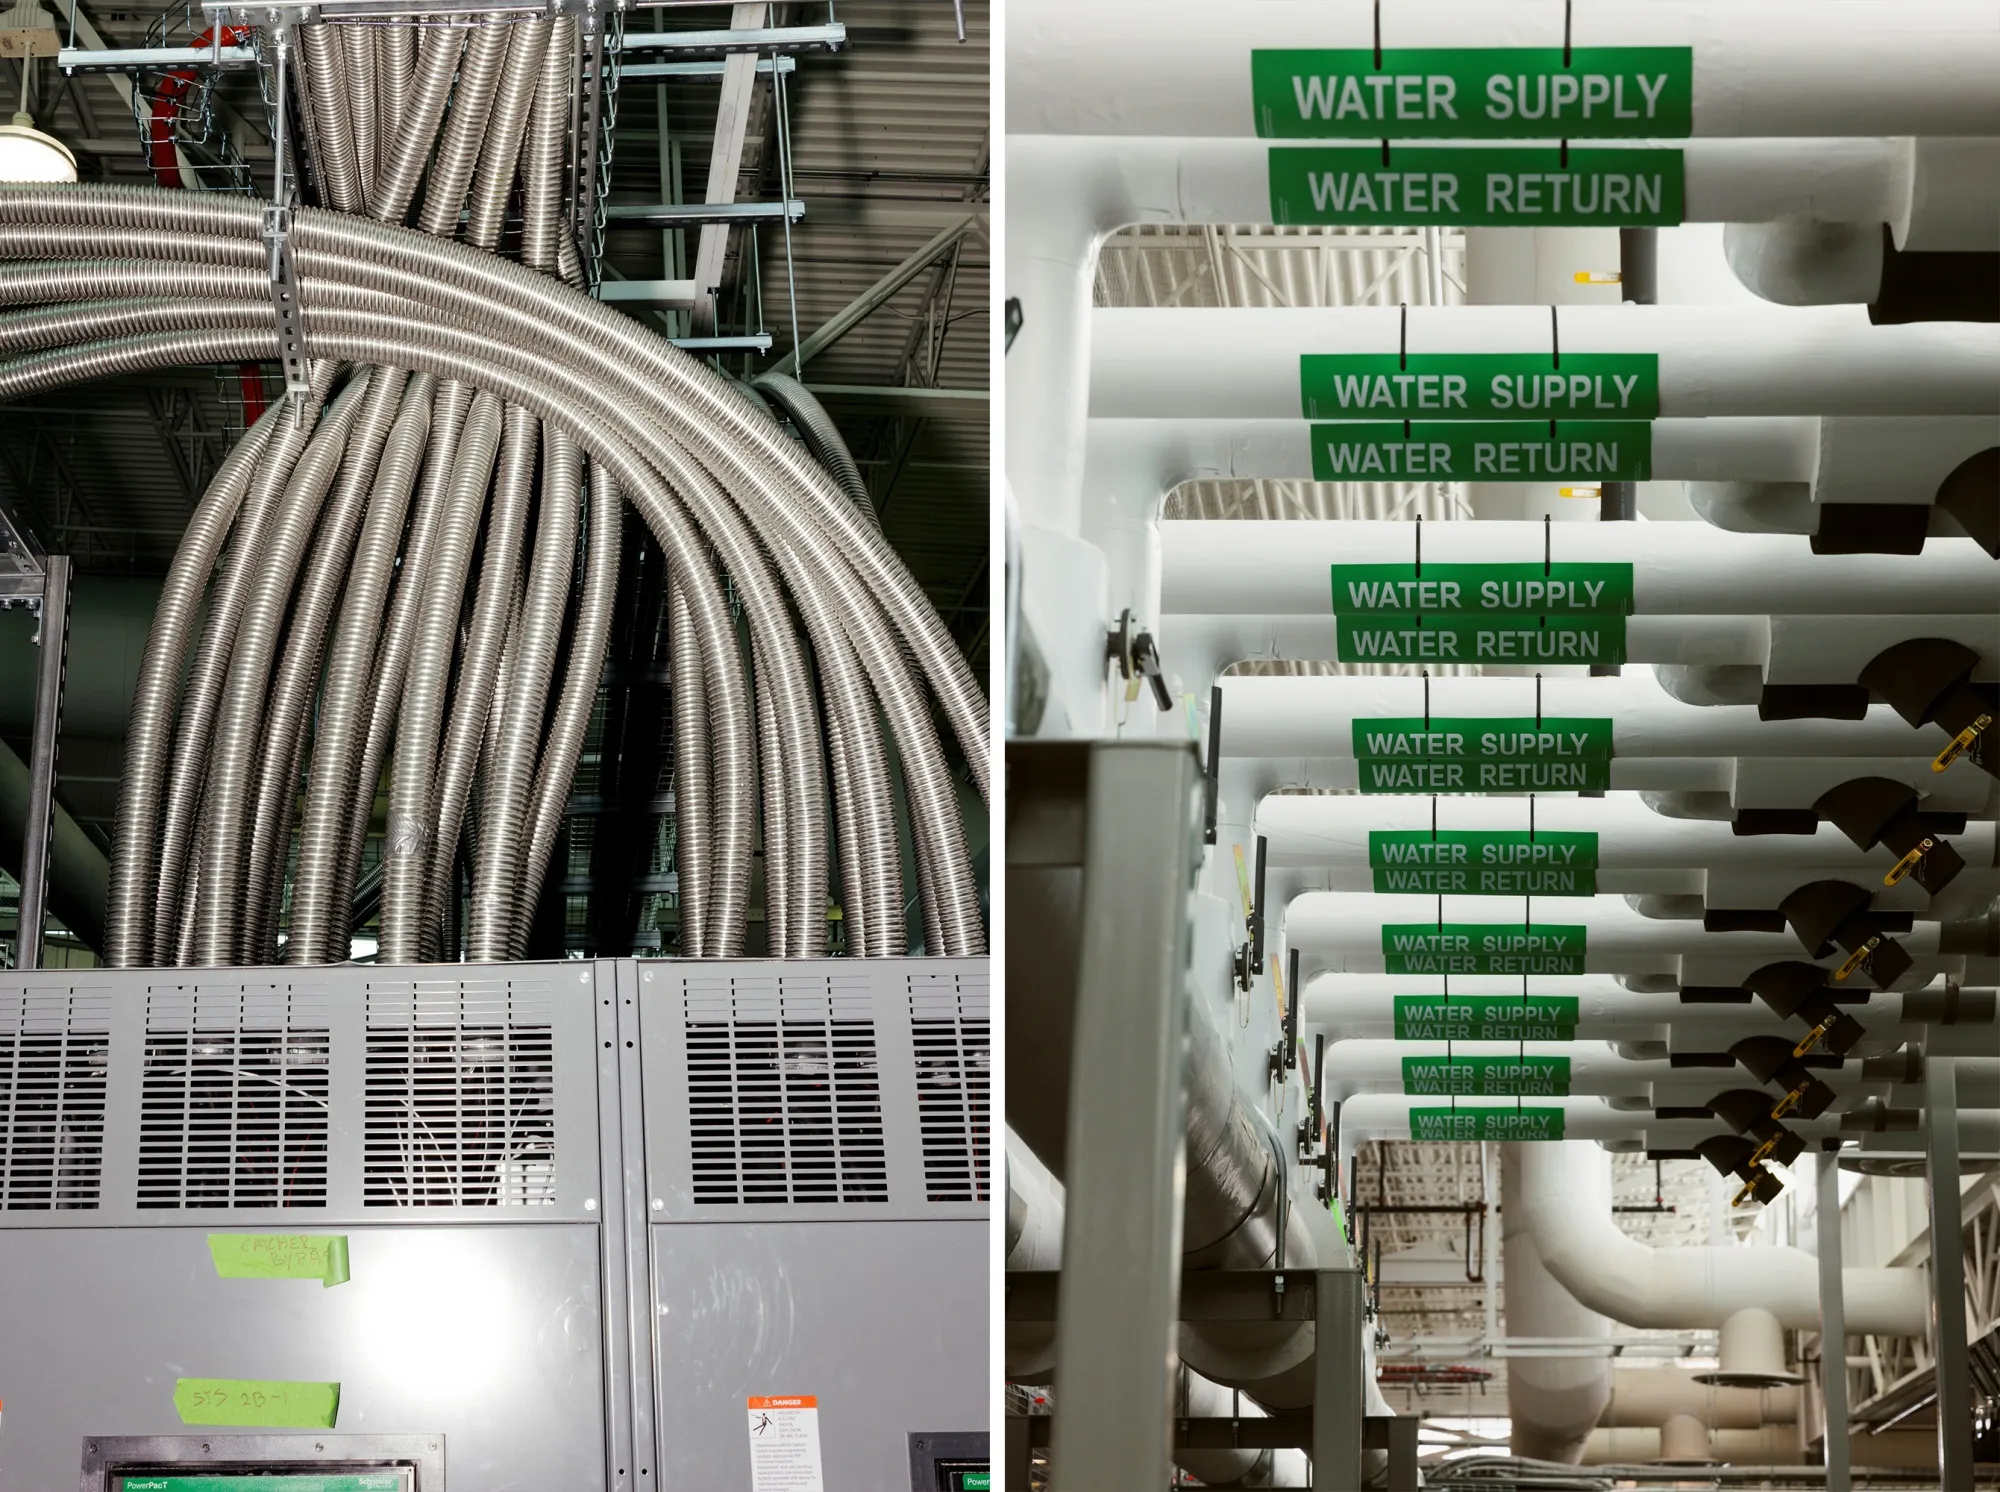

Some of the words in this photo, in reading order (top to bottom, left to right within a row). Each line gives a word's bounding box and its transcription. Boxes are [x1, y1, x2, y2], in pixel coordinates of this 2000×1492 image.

[1291, 74, 1458, 120] WATER
[1485, 74, 1669, 120] SUPPLY
[1307, 173, 1460, 213] WATER
[1486, 173, 1664, 214] RETURN
[1333, 375, 1468, 409] WATER
[1490, 374, 1639, 409] SUPPLY
[1328, 444, 1453, 474] WATER
[1473, 442, 1618, 474] RETURN
[1348, 582, 1462, 608] WATER
[1480, 581, 1605, 608] SUPPLY
[1352, 631, 1459, 656] WATER
[1477, 631, 1599, 657] RETURN
[1367, 733, 1464, 754] WATER
[1481, 733, 1588, 755] SUPPLY
[1372, 765, 1464, 787] WATER
[1479, 764, 1587, 786] RETURN
[1382, 844, 1467, 864] WATER
[1482, 844, 1576, 864] SUPPLY
[1386, 871, 1466, 890] WATER
[1481, 871, 1575, 890] RETURN
[1394, 936, 1470, 952] WATER
[1483, 936, 1567, 952] SUPPLY
[1405, 957, 1477, 971] WATER
[1490, 957, 1574, 972] RETURN
[1404, 1006, 1473, 1021] WATER
[1485, 1006, 1560, 1021] SUPPLY
[1405, 1025, 1470, 1038] WATER
[1482, 1026, 1558, 1039] RETURN
[1411, 1066, 1474, 1079] WATER
[1485, 1066, 1554, 1080] SUPPLY
[1414, 1082, 1473, 1093] WATER
[1484, 1081, 1553, 1094] RETURN
[1418, 1116, 1476, 1128] WATER
[1486, 1116, 1549, 1128] SUPPLY
[241, 1234, 317, 1252] CATCHER
[127, 1481, 168, 1490] PowerPacT
[358, 1477, 392, 1485] Schneider
